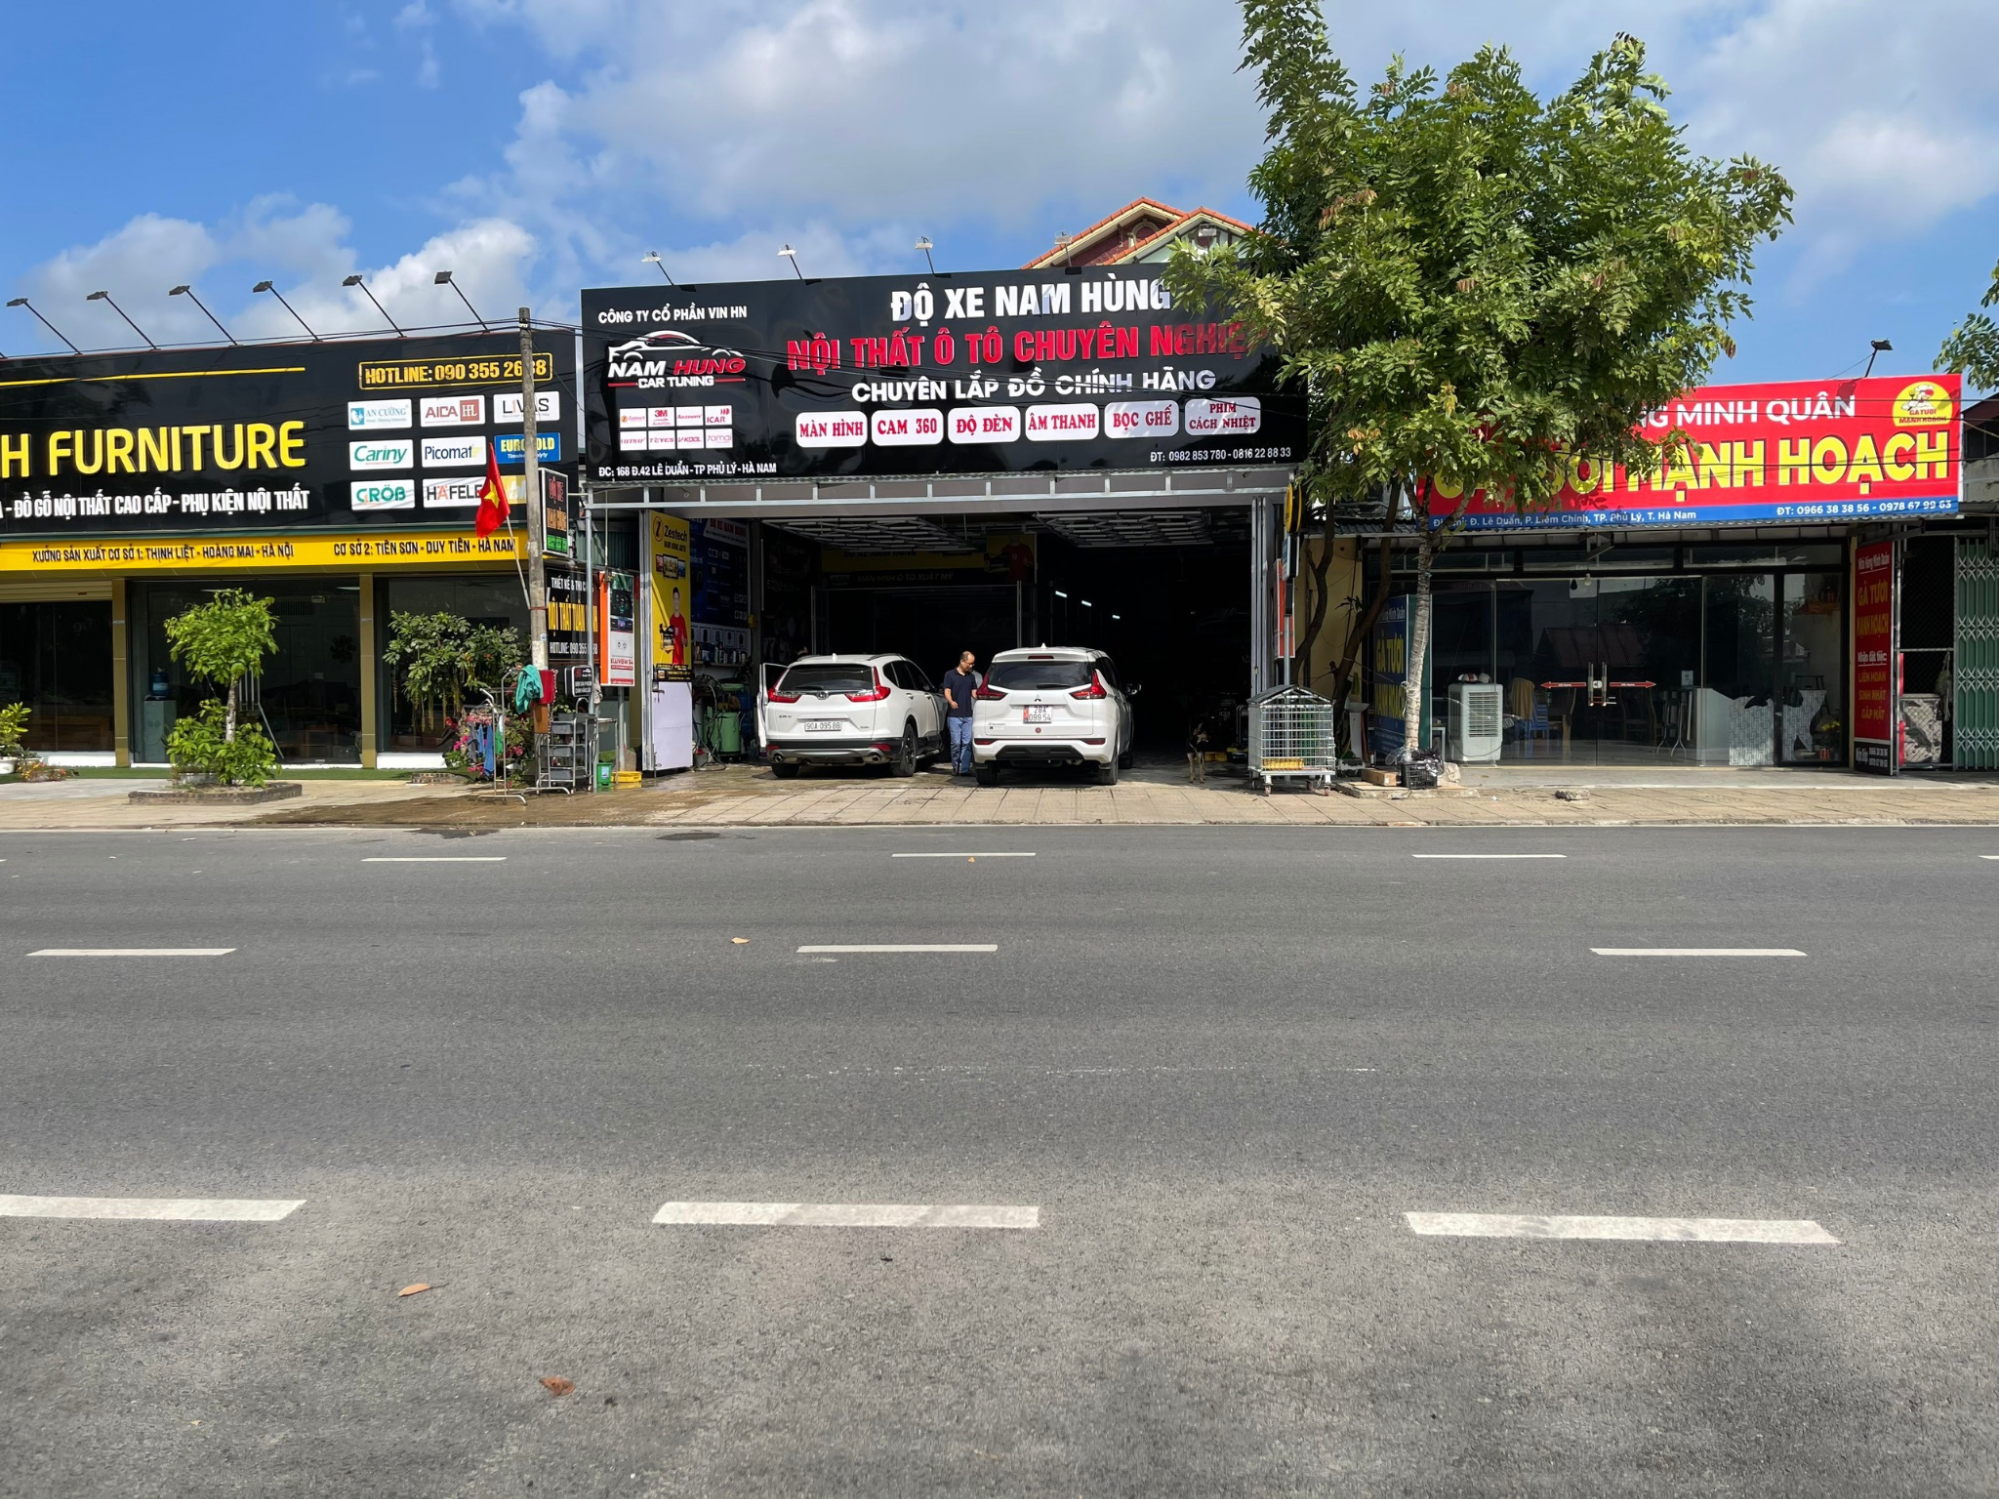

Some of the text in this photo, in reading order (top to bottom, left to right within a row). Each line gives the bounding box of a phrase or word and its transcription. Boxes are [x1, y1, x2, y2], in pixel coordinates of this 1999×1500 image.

[890, 272, 1171, 327] ĐỘ XE NAM HÙNG
[598, 302, 748, 324] CÔNG TY CỔ PHẦN VIN HN
[787, 319, 1267, 376] NỘI THẤT Ô TÔ CHUYÊN NGHIỆ
[365, 366, 432, 384] HOTLINE:
[434, 364, 466, 381] 090
[468, 362, 500, 379] 355
[608, 357, 746, 379] NAM HUNG
[638, 375, 715, 389] CAR TUNING
[852, 366, 1216, 402] CHUYÊN LẮP ĐỒ CHÍNH HÃNG
[366, 409, 377, 417] AN
[425, 406, 458, 419] AICA
[654, 409, 668, 417] 3M
[1208, 402, 1237, 414] PHIM
[1676, 400, 1758, 427] MINH
[1766, 391, 1856, 425] QUÂN
[799, 418, 864, 438] MÀN HÌNH
[877, 417, 938, 435] CAM 360
[956, 414, 1013, 436] ĐỘ ĐÈN
[1028, 412, 1096, 430] ÂM THANH
[1112, 404, 1173, 433] BỌC GHẾ
[1189, 415, 1256, 431] CÁCH NHIỆT
[49, 421, 306, 476] FURNITURE
[354, 445, 407, 465] Cariny
[424, 445, 473, 460] Picomat
[1150, 447, 1291, 462] ĐT: 0982 853 780 0816 22 88 33
[599, 460, 777, 477] ĐC: 168 Đ.42 LÊ DUẨN TP PHỦ LÝ HÀ NAM
[1778, 431, 1950, 495] HOẠCH
[14, 482, 310, 520] ĐỒ GỖ NỘI THẤT CAO PHỤ KIỆN NỘI THẤT
[426, 484, 483, 501] HÄFELE
[1482, 516, 1494, 526] Lê
[1525, 515, 1534, 524] P.
[1561, 513, 1591, 524] Chính,
[1594, 513, 1608, 523] TP.
[1611, 511, 1628, 522] Phủ
[1631, 511, 1644, 523] Lý,
[1647, 511, 1656, 520] T.
[1658, 510, 1672, 520] Hà
[1675, 509, 1697, 519] Nam
[1776, 505, 1794, 517] ĐT:
[1797, 504, 1824, 516] 0966
[1826, 504, 1839, 515] 38
[1841, 503, 1854, 514] 38
[1856, 502, 1870, 513] 56
[1879, 501, 1905, 512] 0978
[1907, 501, 1921, 510] 67
[1923, 500, 1936, 510] 99
[664, 524, 688, 542] Zestech
[63, 544, 81, 561] SẢN
[83, 543, 106, 560] XUẤT
[136, 547, 144, 559] 1:
[145, 546, 173, 563] THỊNH
[175, 544, 195, 561] LIỆT
[202, 544, 234, 558] HOÀNG
[236, 545, 254, 558] MAI
[261, 543, 275, 557] HÀ
[277, 542, 294, 558] NỘI
[333, 536, 515, 556] CƠ SỞ 2: TIÊN SƠN DUY TIÊN HÀ NAM
[1858, 581, 1868, 607] GÀ
